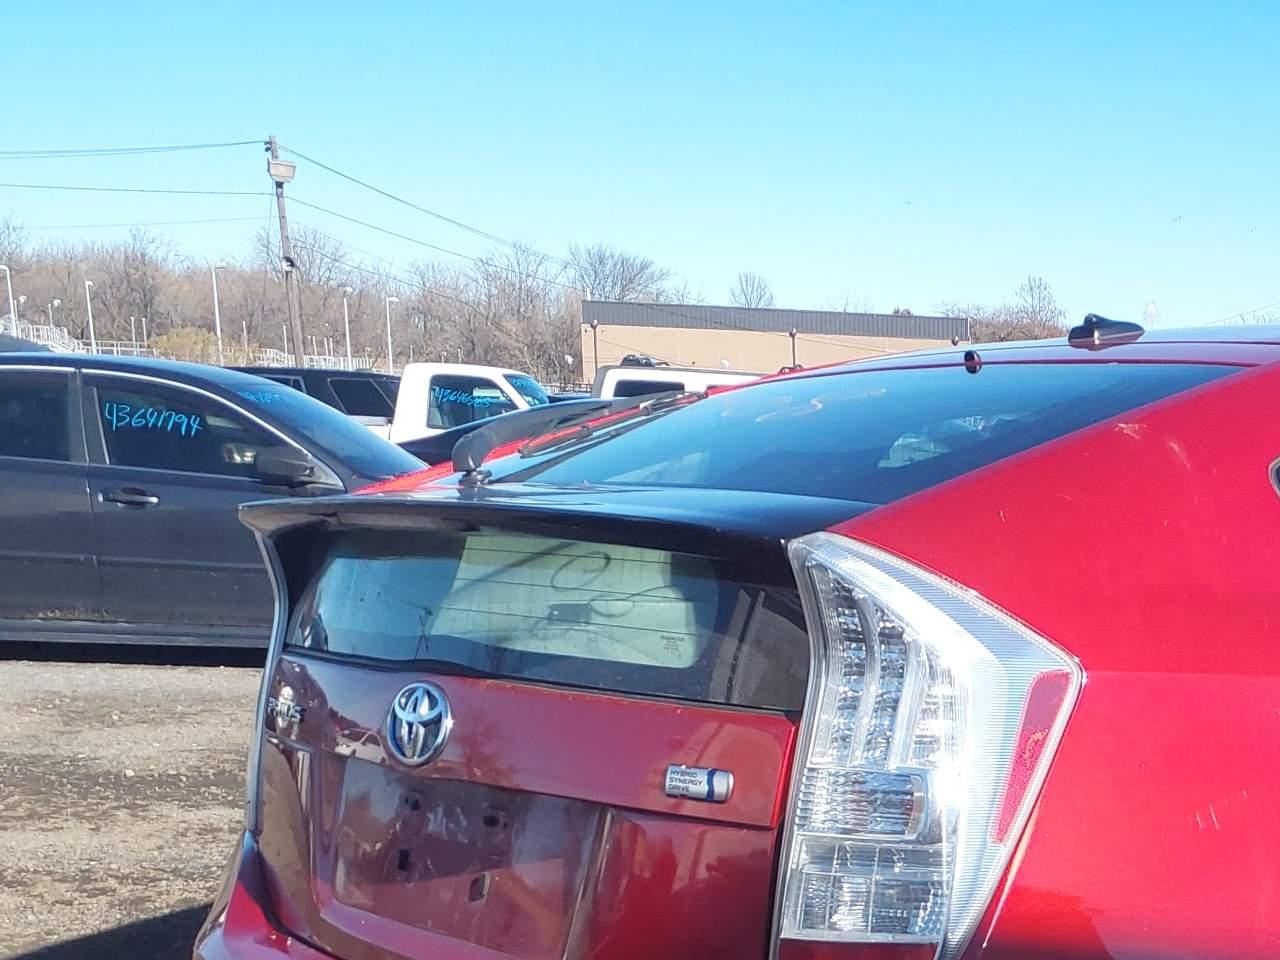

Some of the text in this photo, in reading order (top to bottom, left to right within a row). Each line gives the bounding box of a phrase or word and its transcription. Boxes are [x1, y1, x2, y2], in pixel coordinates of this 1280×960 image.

[105, 403, 203, 437] 43641794
[670, 769, 698, 778] HYBRID
[669, 777, 703, 786] SYNERGY
[668, 784, 690, 792] DRIVE
